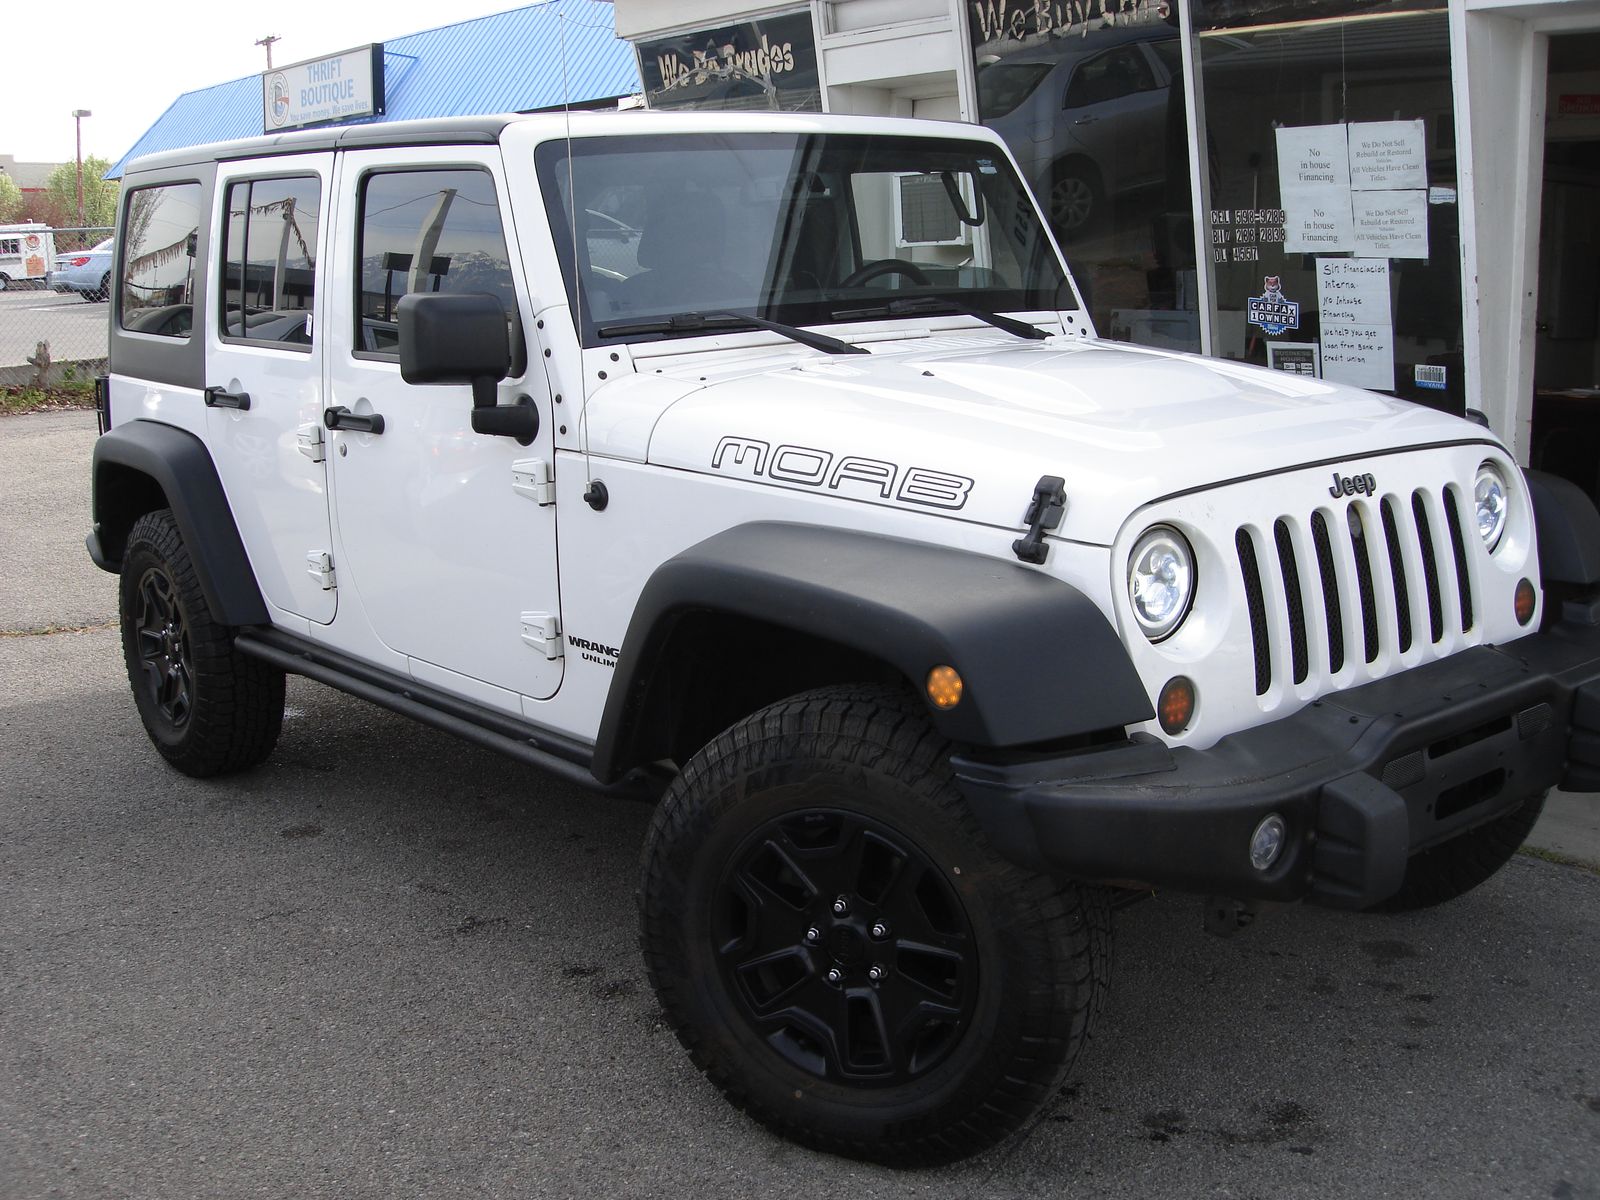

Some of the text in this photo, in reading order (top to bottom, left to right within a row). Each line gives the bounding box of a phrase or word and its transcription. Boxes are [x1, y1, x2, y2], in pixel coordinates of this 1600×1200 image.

[307, 59, 342, 84] THRIFT
[301, 79, 354, 107] BOUTIQUE
[1393, 139, 1405, 147] Sell
[1309, 148, 1321, 157] No
[1300, 161, 1331, 169] in house
[1361, 164, 1385, 172] Vehicles
[1298, 173, 1334, 184] Financing
[1211, 211, 1230, 224] CEL
[1313, 209, 1325, 217] No
[1304, 220, 1335, 230] in house
[1302, 232, 1338, 243] Financing
[1404, 232, 1422, 240] Clean
[1233, 246, 1258, 261] 4557
[1251, 302, 1295, 316] CARFAX
[1323, 310, 1355, 322] Financing
[1365, 330, 1377, 340] get
[711, 435, 976, 511] MOAB
[1328, 472, 1377, 499] Jeep
[568, 634, 620, 658] WRANG
